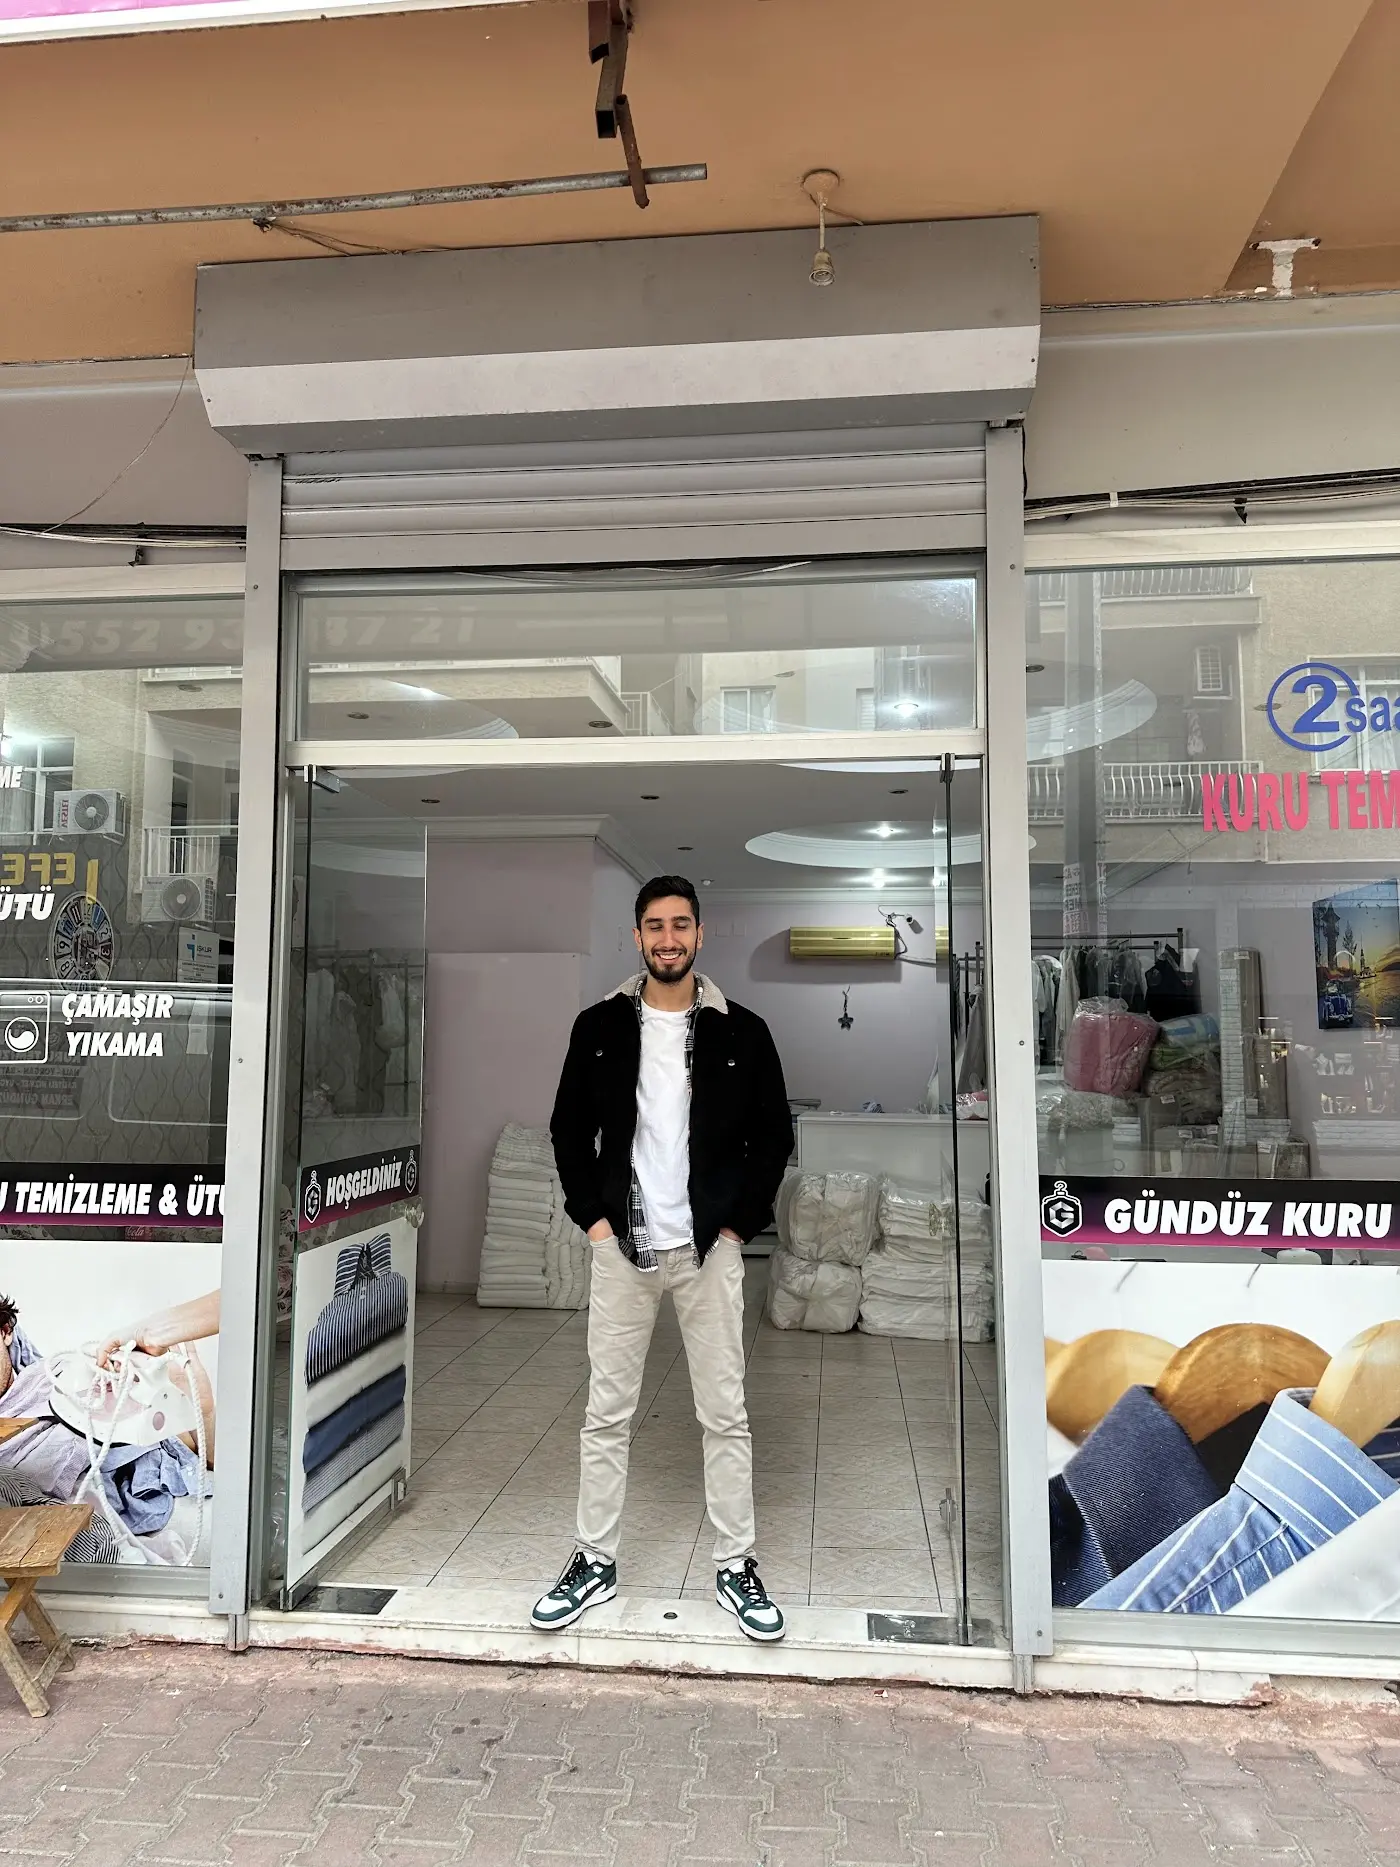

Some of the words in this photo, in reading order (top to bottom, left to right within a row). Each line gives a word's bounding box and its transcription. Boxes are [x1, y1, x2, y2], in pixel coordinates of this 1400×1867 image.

[1292, 675, 1340, 733] 2
[1202, 772, 1309, 832] KURU
[1320, 770, 1400, 830] TEM
[61, 992, 175, 1026] ÇAMAŞIR
[66, 1031, 164, 1057] YIKAMA
[15, 1173, 152, 1215] TEMİZLEME
[158, 1183, 178, 1216] &
[325, 1155, 403, 1210] HOŞGELDİNİZ
[1104, 1189, 1273, 1236] GÜNDÜZ
[1282, 1202, 1393, 1239] KURU
